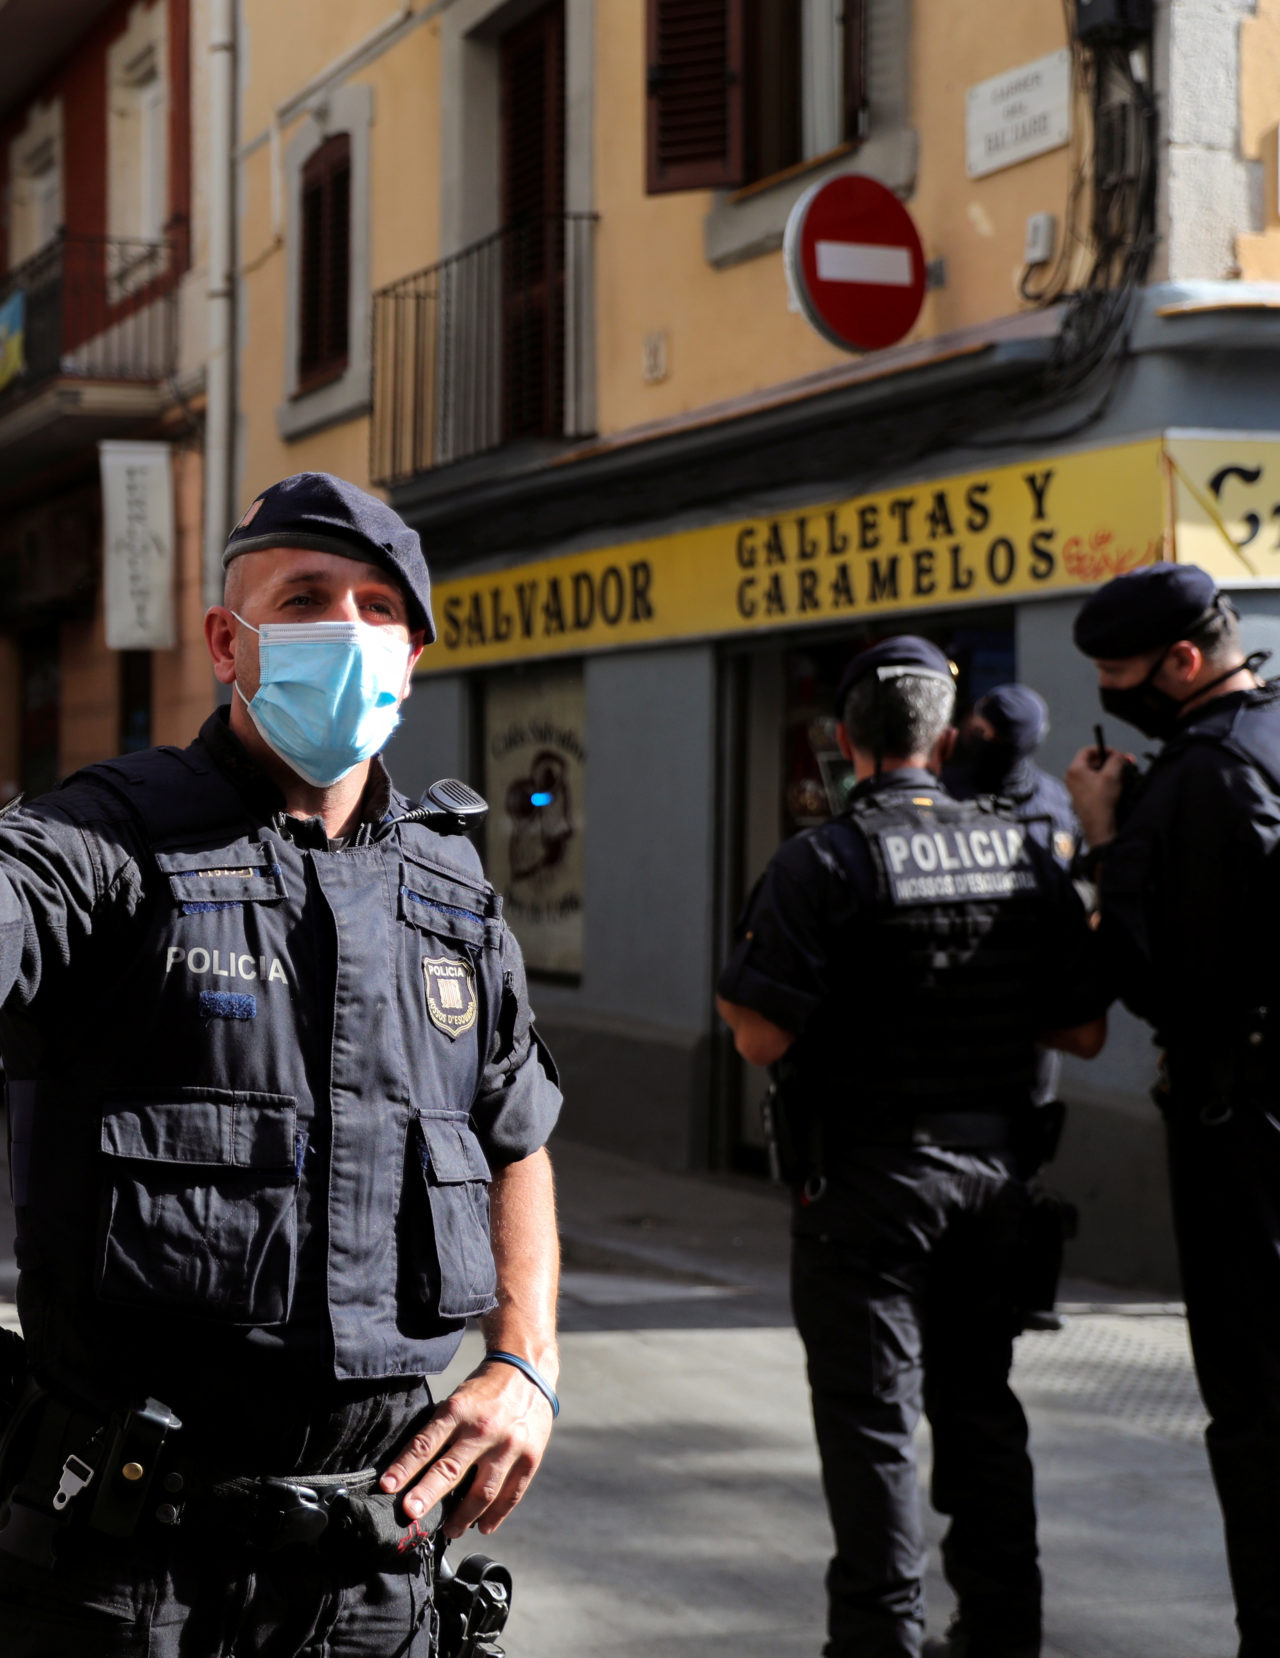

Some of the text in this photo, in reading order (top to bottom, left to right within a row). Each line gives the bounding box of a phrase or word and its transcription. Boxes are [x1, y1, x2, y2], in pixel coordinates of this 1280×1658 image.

[735, 481, 990, 570] GALLETAS
[1024, 468, 1055, 521] Y
[443, 559, 654, 652] SALVADOR
[735, 529, 1056, 620] CARAMELOS
[885, 828, 1031, 874] POLICIA
[165, 946, 289, 985] POLICIA
[427, 964, 465, 978] POLICIA
